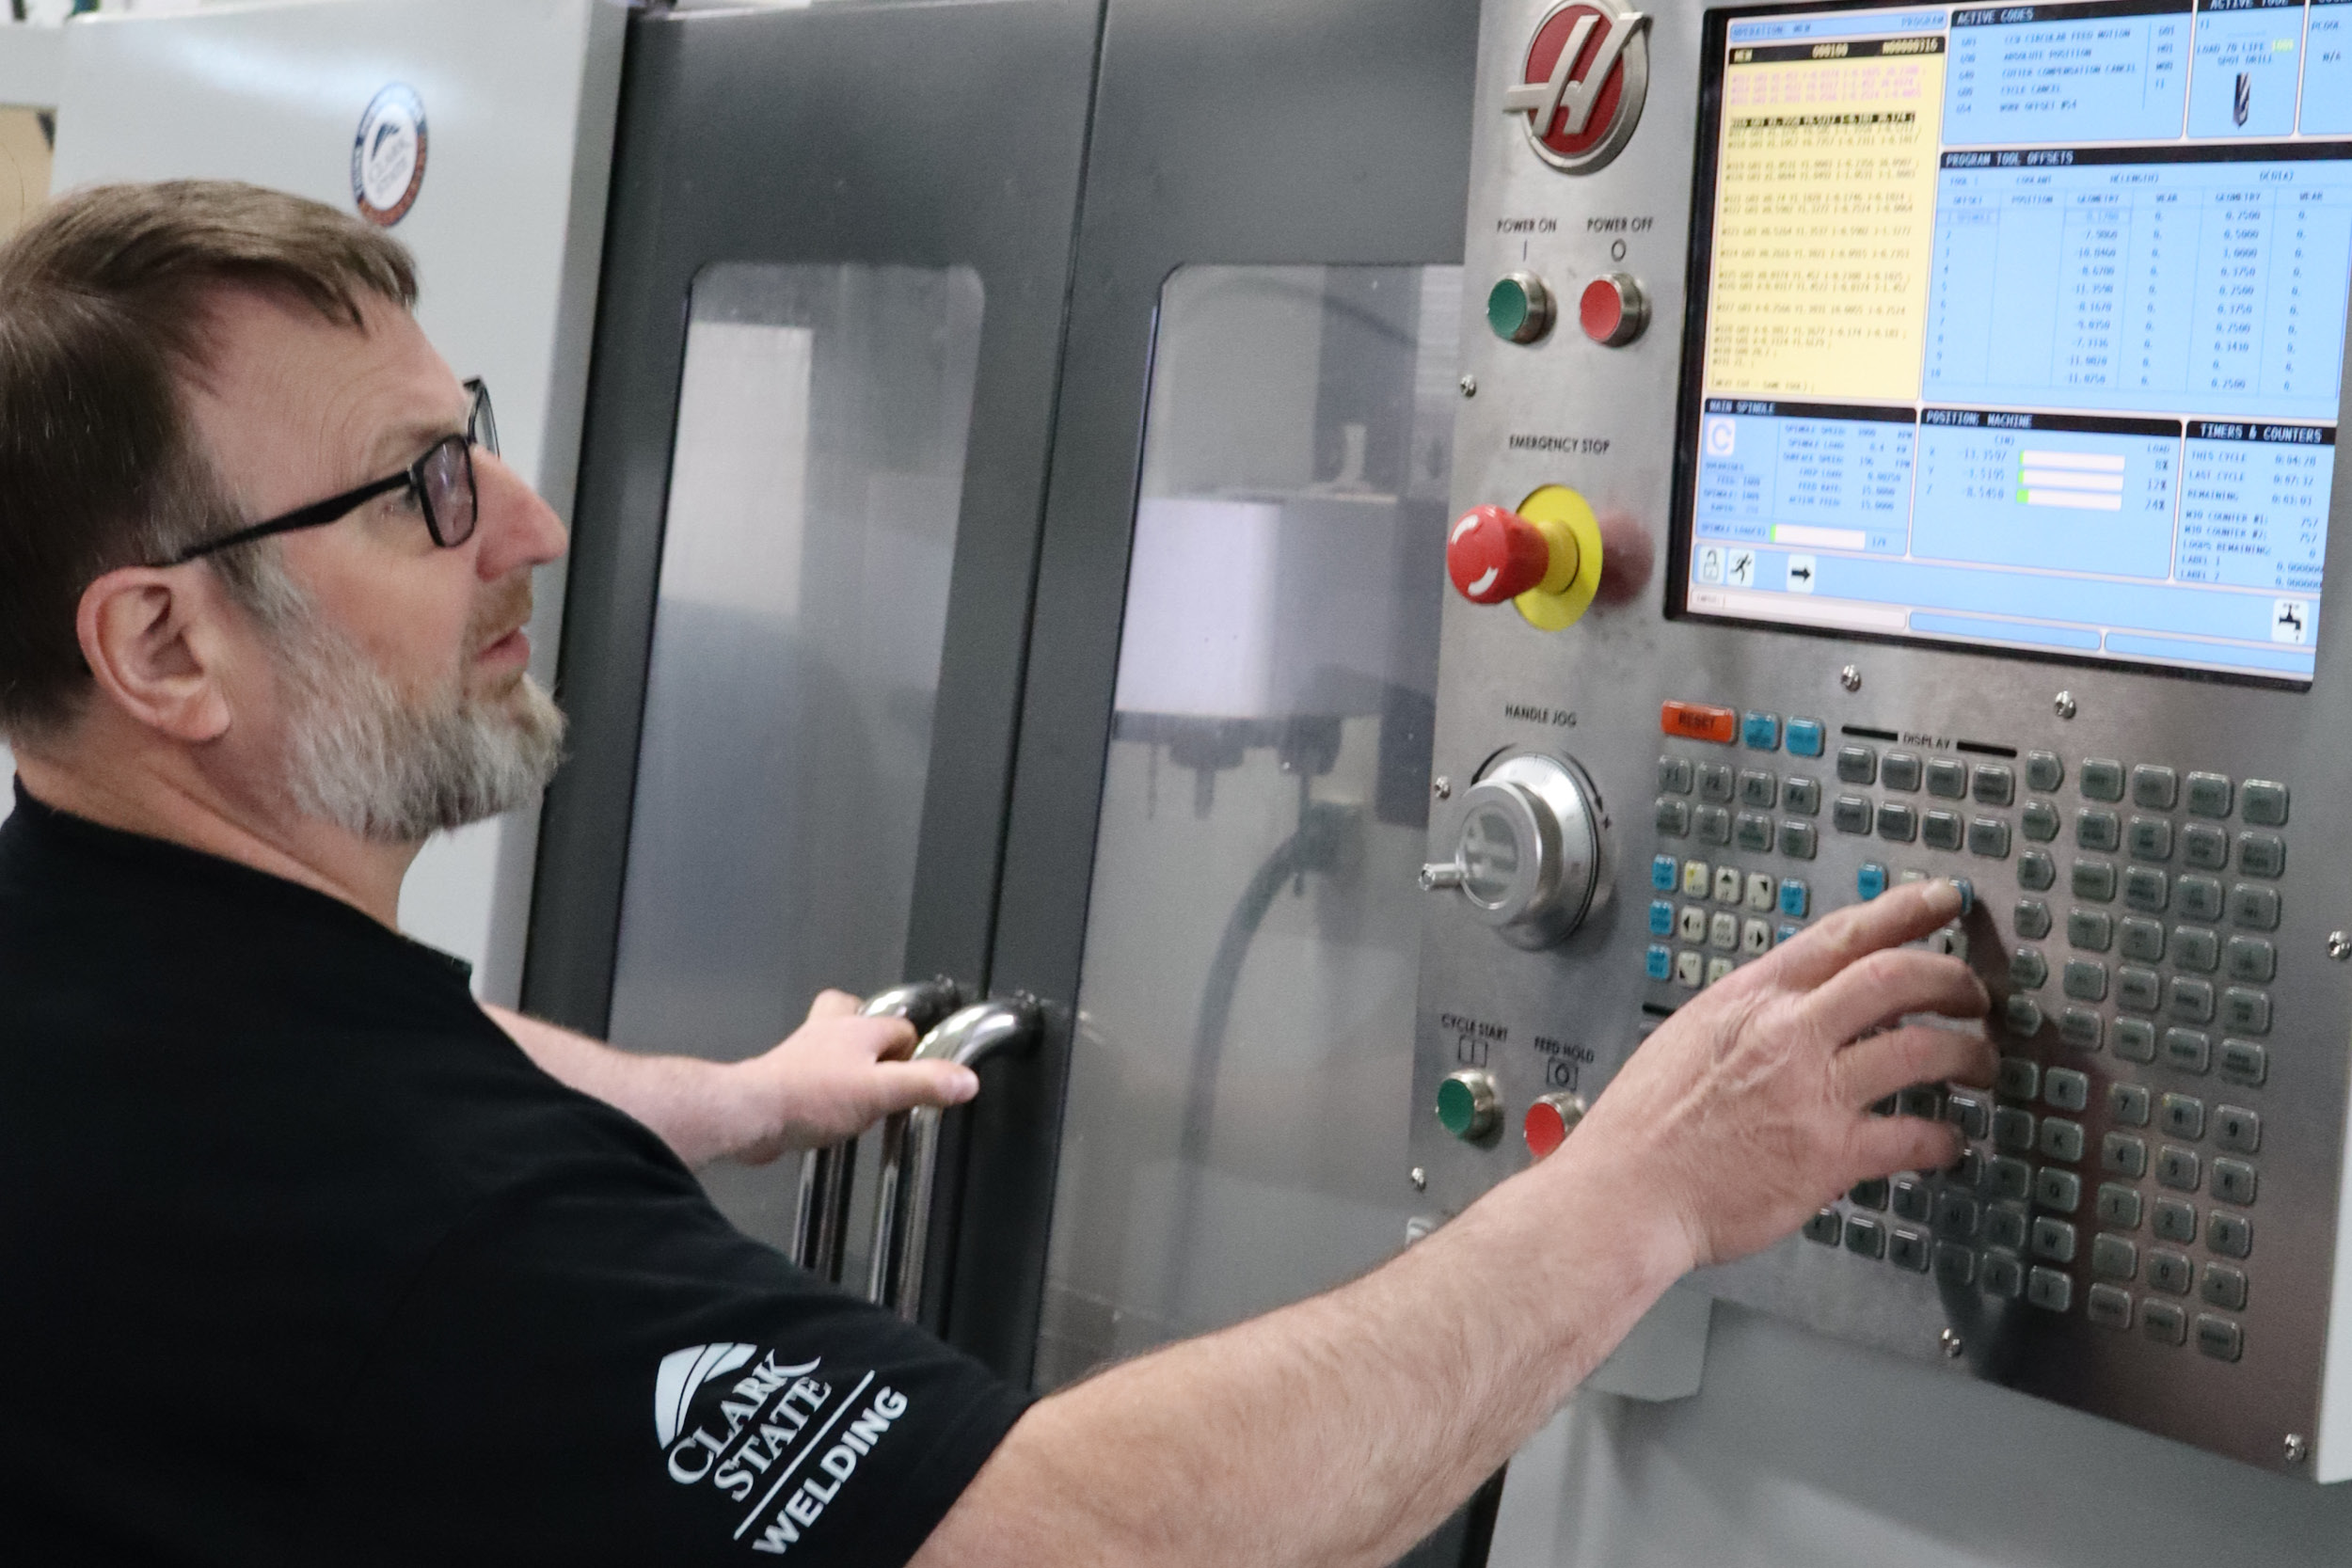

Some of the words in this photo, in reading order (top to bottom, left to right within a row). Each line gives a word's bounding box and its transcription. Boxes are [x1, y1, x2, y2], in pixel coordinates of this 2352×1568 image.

[1957, 9, 1995, 24] ACTIVE
[2000, 8, 2034, 22] CODES
[1946, 152, 1991, 166] PROGRAM
[1996, 151, 2021, 166] TOOL
[2026, 150, 2074, 165] OFFSETS
[1497, 218, 1534, 232] POWER
[1538, 218, 1557, 232] ON
[1587, 217, 1627, 232] POWER
[1631, 216, 1654, 232] OFF
[1708, 401, 1732, 413] MAIN
[1987, 413, 2033, 428] MACHINE
[2200, 422, 2244, 440] TIMERS
[2249, 425, 2258, 440] &
[2264, 427, 2323, 444] COUNTERS
[1509, 435, 1579, 452] EMERGENCY
[1581, 438, 1610, 454] STOP
[2186, 489, 2239, 502] REMAINING
[1505, 705, 1549, 723] HANDLE
[1552, 710, 1577, 727] JOG
[1903, 731, 1950, 750] DISPLAY
[1441, 1013, 1476, 1034] CYCLE
[1479, 1022, 1508, 1039] START
[1534, 1037, 1561, 1054] FEED
[1563, 1043, 1595, 1063] HOLD
[667, 1348, 821, 1484] CLARK
[713, 1376, 833, 1503] STATE
[752, 1386, 908, 1554] WELDING
